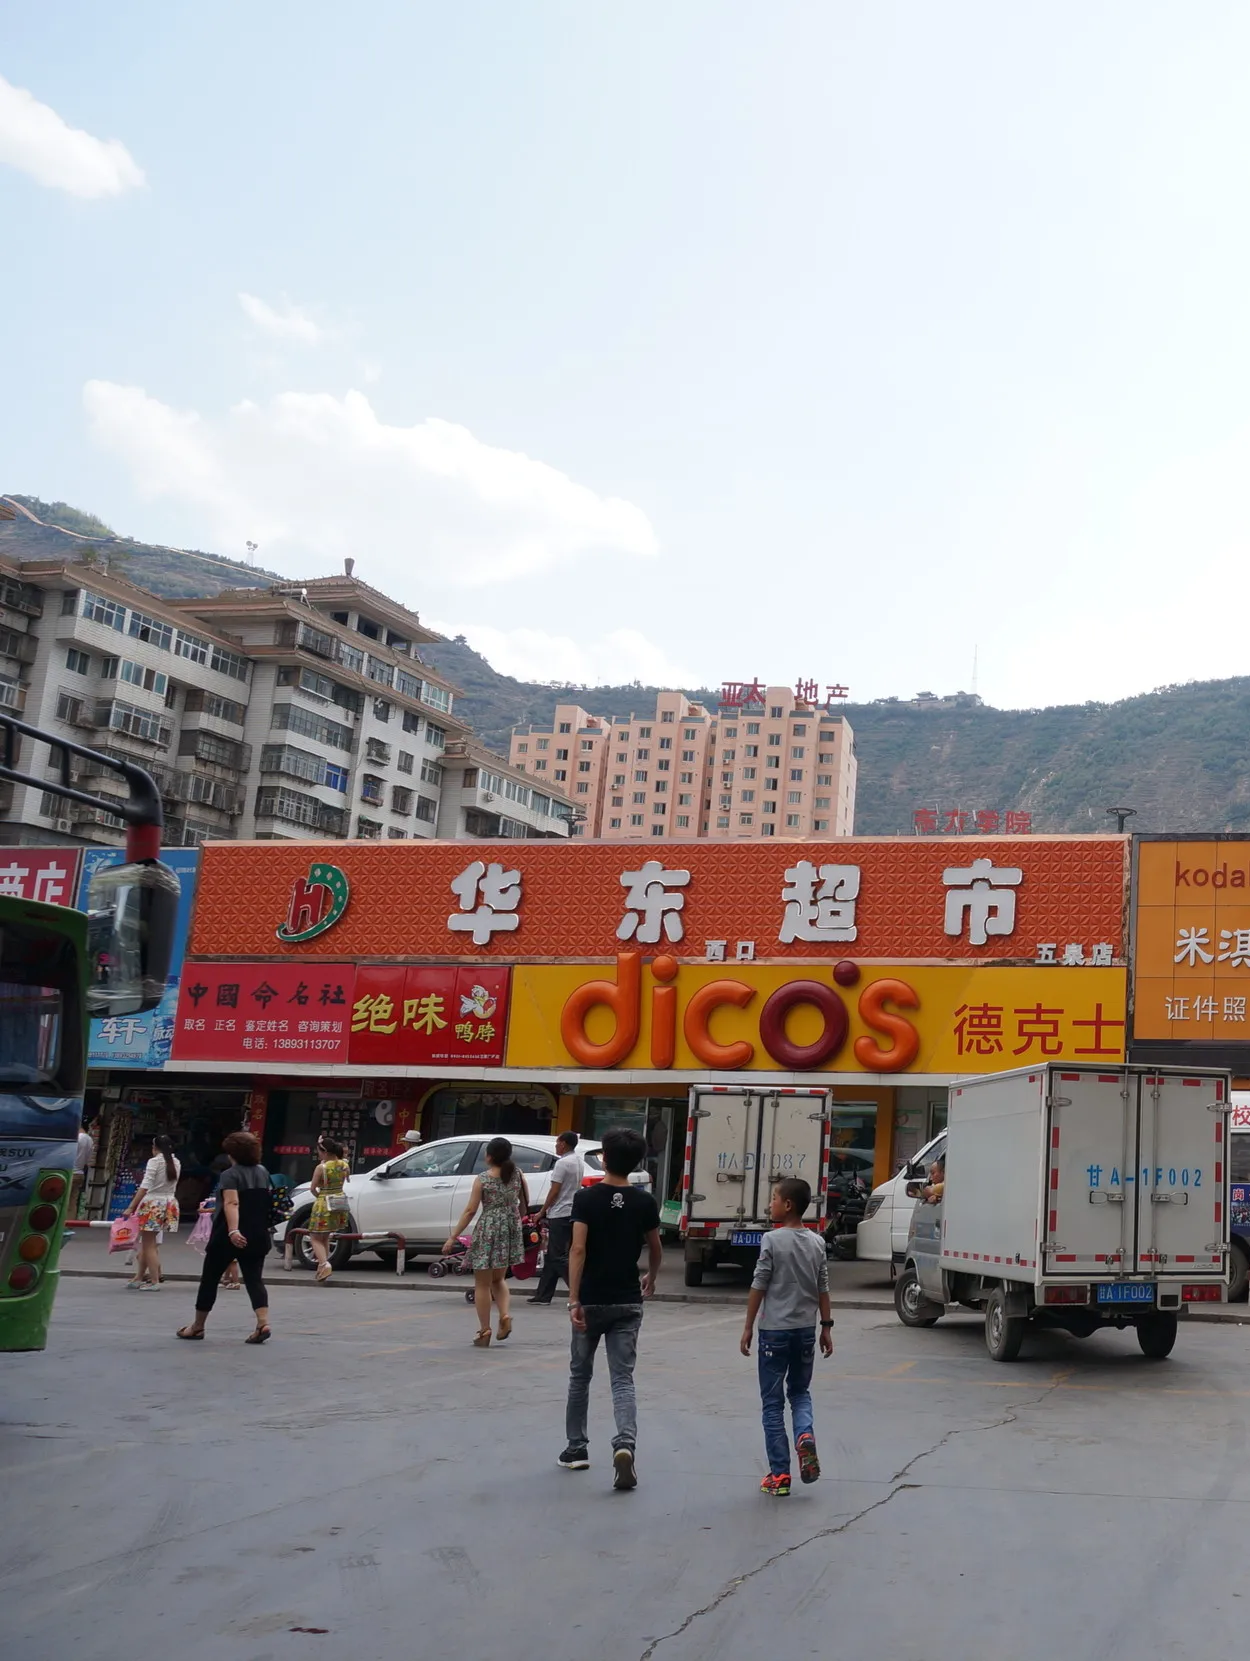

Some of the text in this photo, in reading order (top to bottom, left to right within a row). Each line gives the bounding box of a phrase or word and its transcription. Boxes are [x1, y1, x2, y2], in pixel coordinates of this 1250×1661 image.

[718, 677, 849, 710] 亚太地产
[447, 858, 1023, 946] 华东超市
[705, 939, 756, 961] 西口
[1035, 943, 1114, 966] 五泉店
[351, 993, 496, 1043] 绝味 鸭脖
[1165, 995, 1247, 1023] 证件照
[183, 1018, 343, 1033] 取名 正名 鉴定姓名 咨询策划
[953, 1003, 1126, 1057] 德克士
[1087, 1164, 1202, 1188] 甘A-1F002
